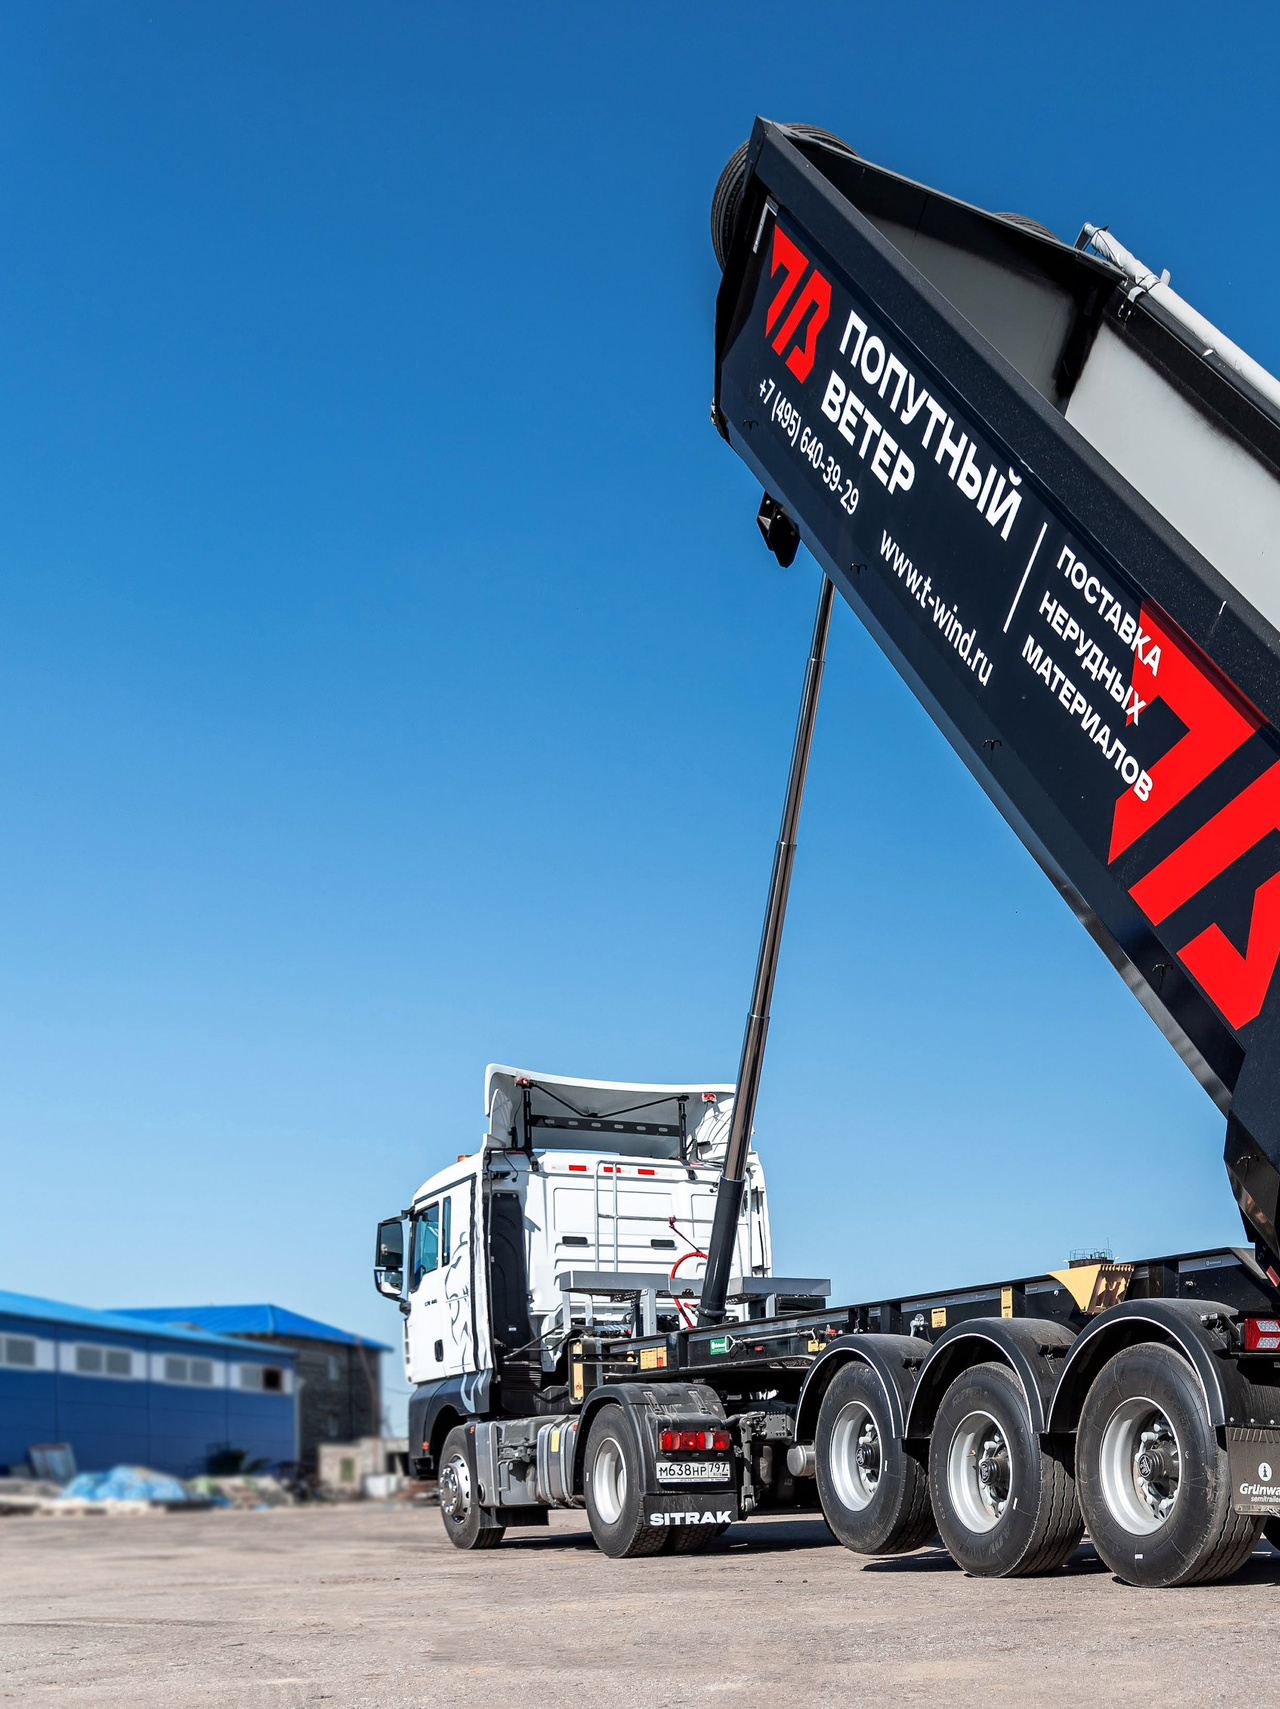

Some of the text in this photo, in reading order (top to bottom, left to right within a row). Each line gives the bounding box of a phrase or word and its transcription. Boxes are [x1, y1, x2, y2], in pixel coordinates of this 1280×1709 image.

[759, 378, 859, 515] +7 (495) 640-39-29
[820, 369, 916, 495] ВЕТЕР
[839, 309, 1023, 541] ПОПУТНЫЙ
[880, 529, 994, 687] www.t-wind.ru
[1038, 590, 1147, 727] НЕРУДНЫХ
[1056, 544, 1162, 677] ПОСТАВКА
[1021, 634, 1153, 802] МАТЕРИАЛОВ
[649, 1510, 732, 1526] SITRAK
[709, 1462, 726, 1473] 797
